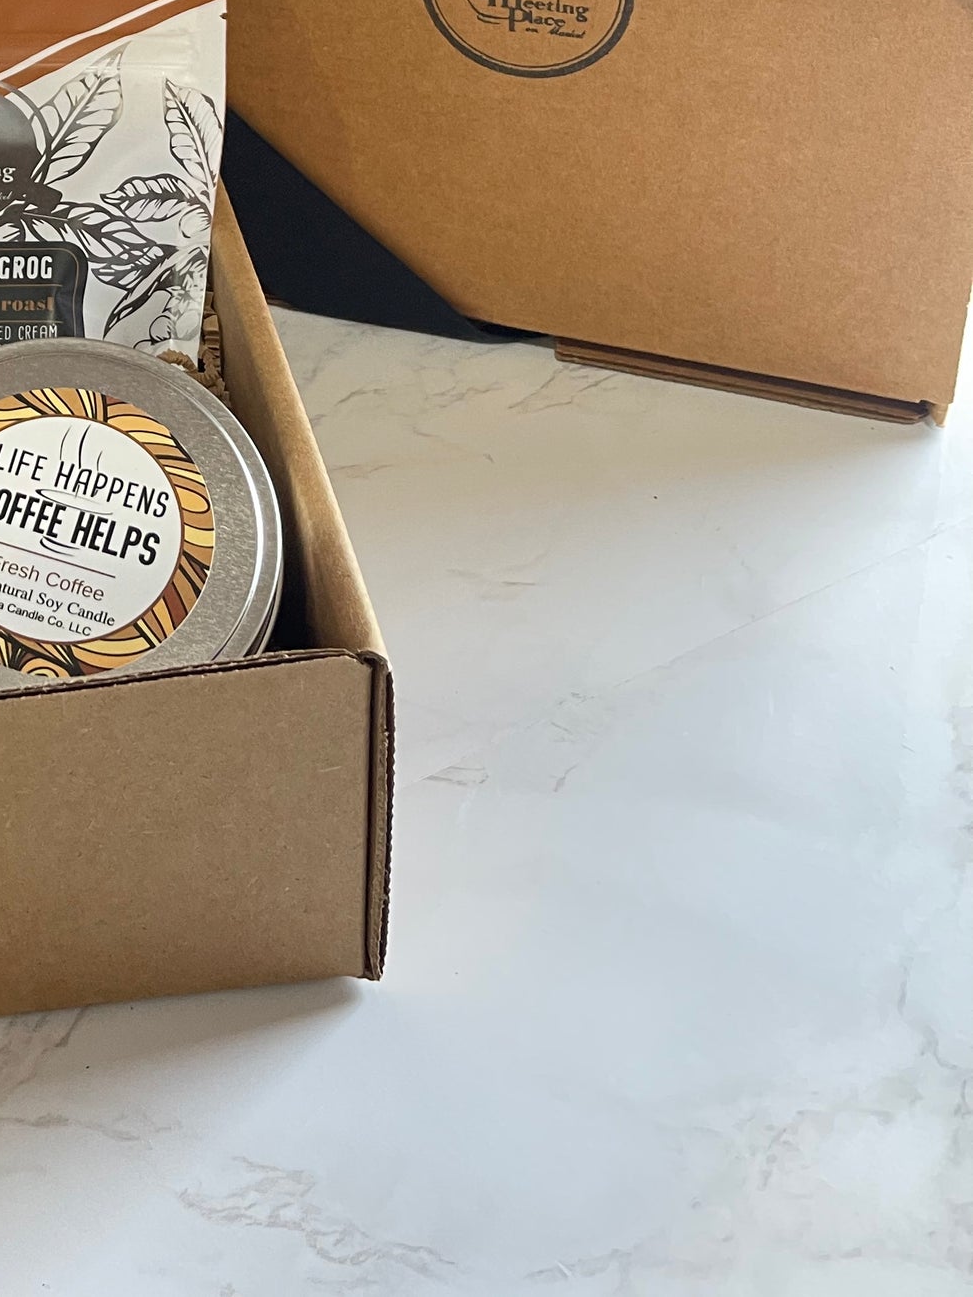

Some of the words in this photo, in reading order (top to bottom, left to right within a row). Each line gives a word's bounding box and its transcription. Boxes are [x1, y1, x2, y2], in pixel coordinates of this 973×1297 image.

[508, 6, 566, 33] Place
[1, 296, 56, 313] roast
[18, 323, 59, 340] CREAM
[54, 460, 170, 518] HAPPENS
[70, 511, 161, 566] HELPS
[45, 571, 105, 602] Coffee
[6, 603, 45, 623] Candle
[47, 615, 66, 630] Co.
[68, 621, 93, 637] LLC
[36, 592, 64, 613] Soy
[67, 601, 116, 627] Candle
